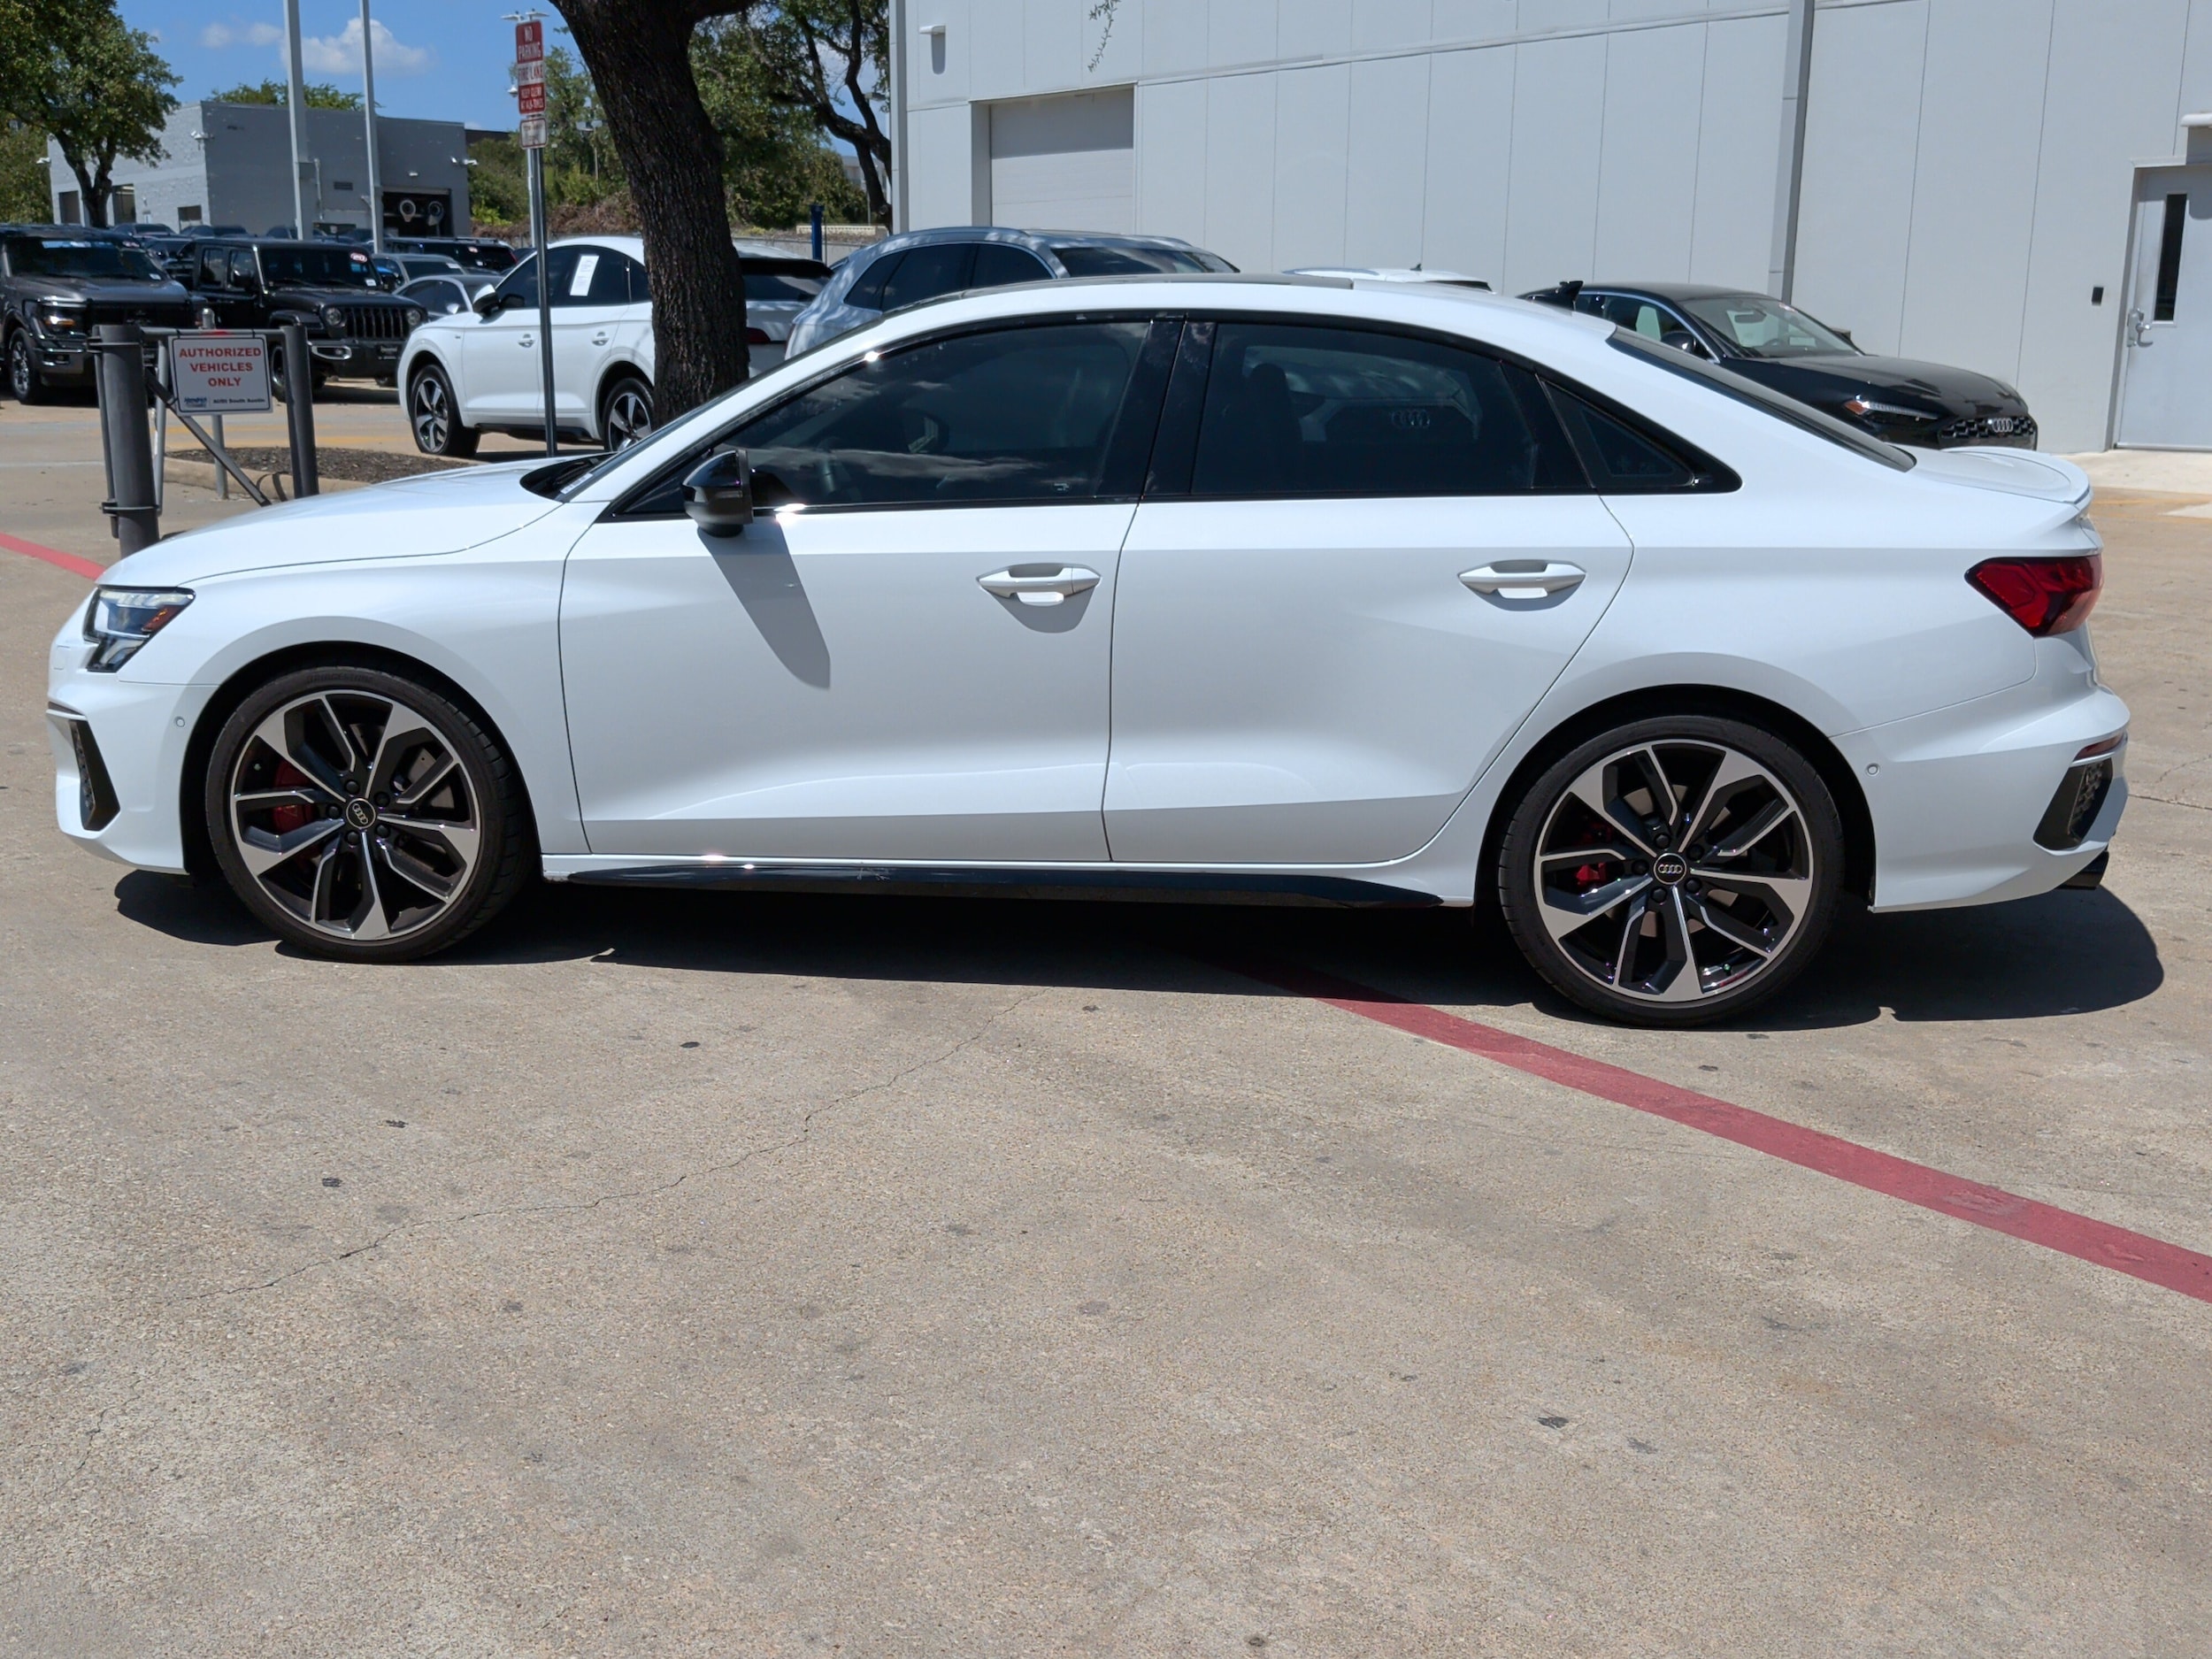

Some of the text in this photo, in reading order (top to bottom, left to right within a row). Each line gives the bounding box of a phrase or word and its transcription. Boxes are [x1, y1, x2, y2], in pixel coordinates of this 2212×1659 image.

[524, 26, 534, 42] NO
[518, 42, 541, 60] PARKING
[531, 65, 543, 80] LANE
[180, 348, 262, 357] AUTHORIZED
[190, 362, 253, 373] VEHICLES
[208, 378, 242, 387] ONLY
